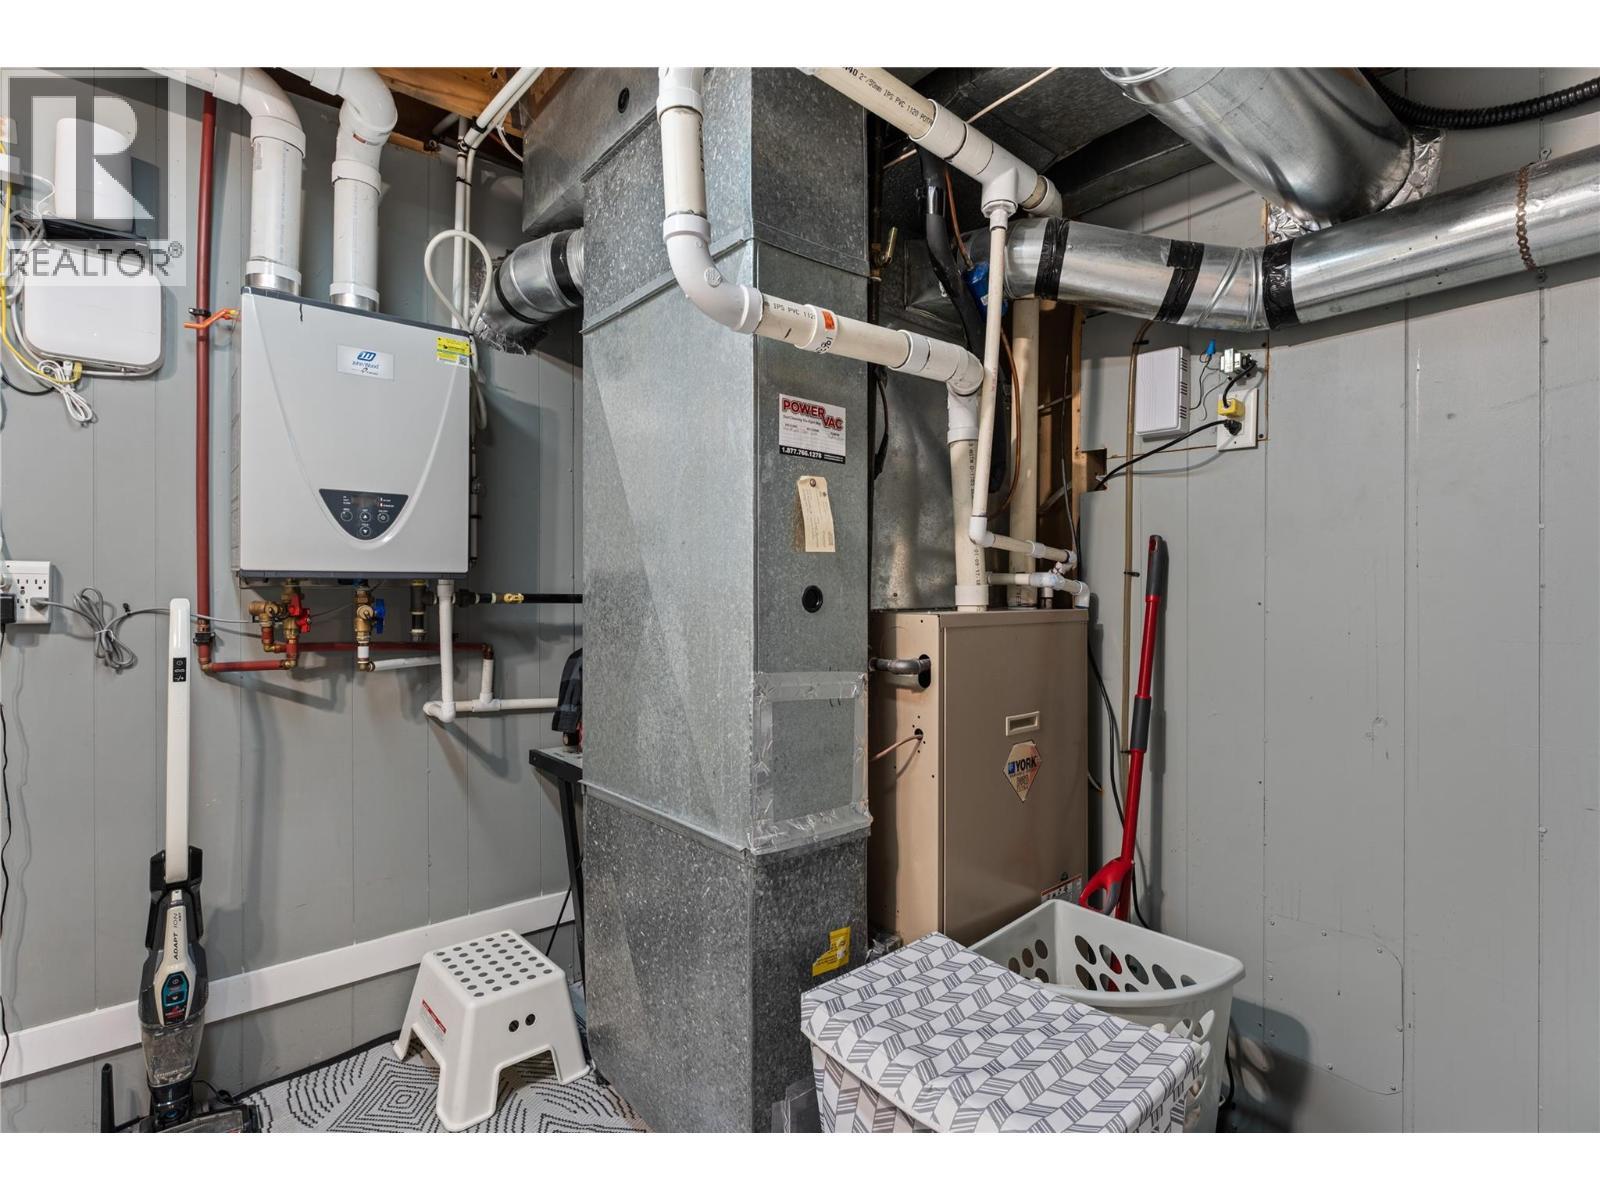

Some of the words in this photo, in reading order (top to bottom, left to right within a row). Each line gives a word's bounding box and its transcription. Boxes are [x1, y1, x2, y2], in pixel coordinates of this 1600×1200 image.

[895, 97, 906, 108] PVC
[803, 311, 816, 320] 112
[782, 398, 826, 420] POWER
[823, 415, 843, 431] VAC
[1015, 757, 1037, 771] YORK
